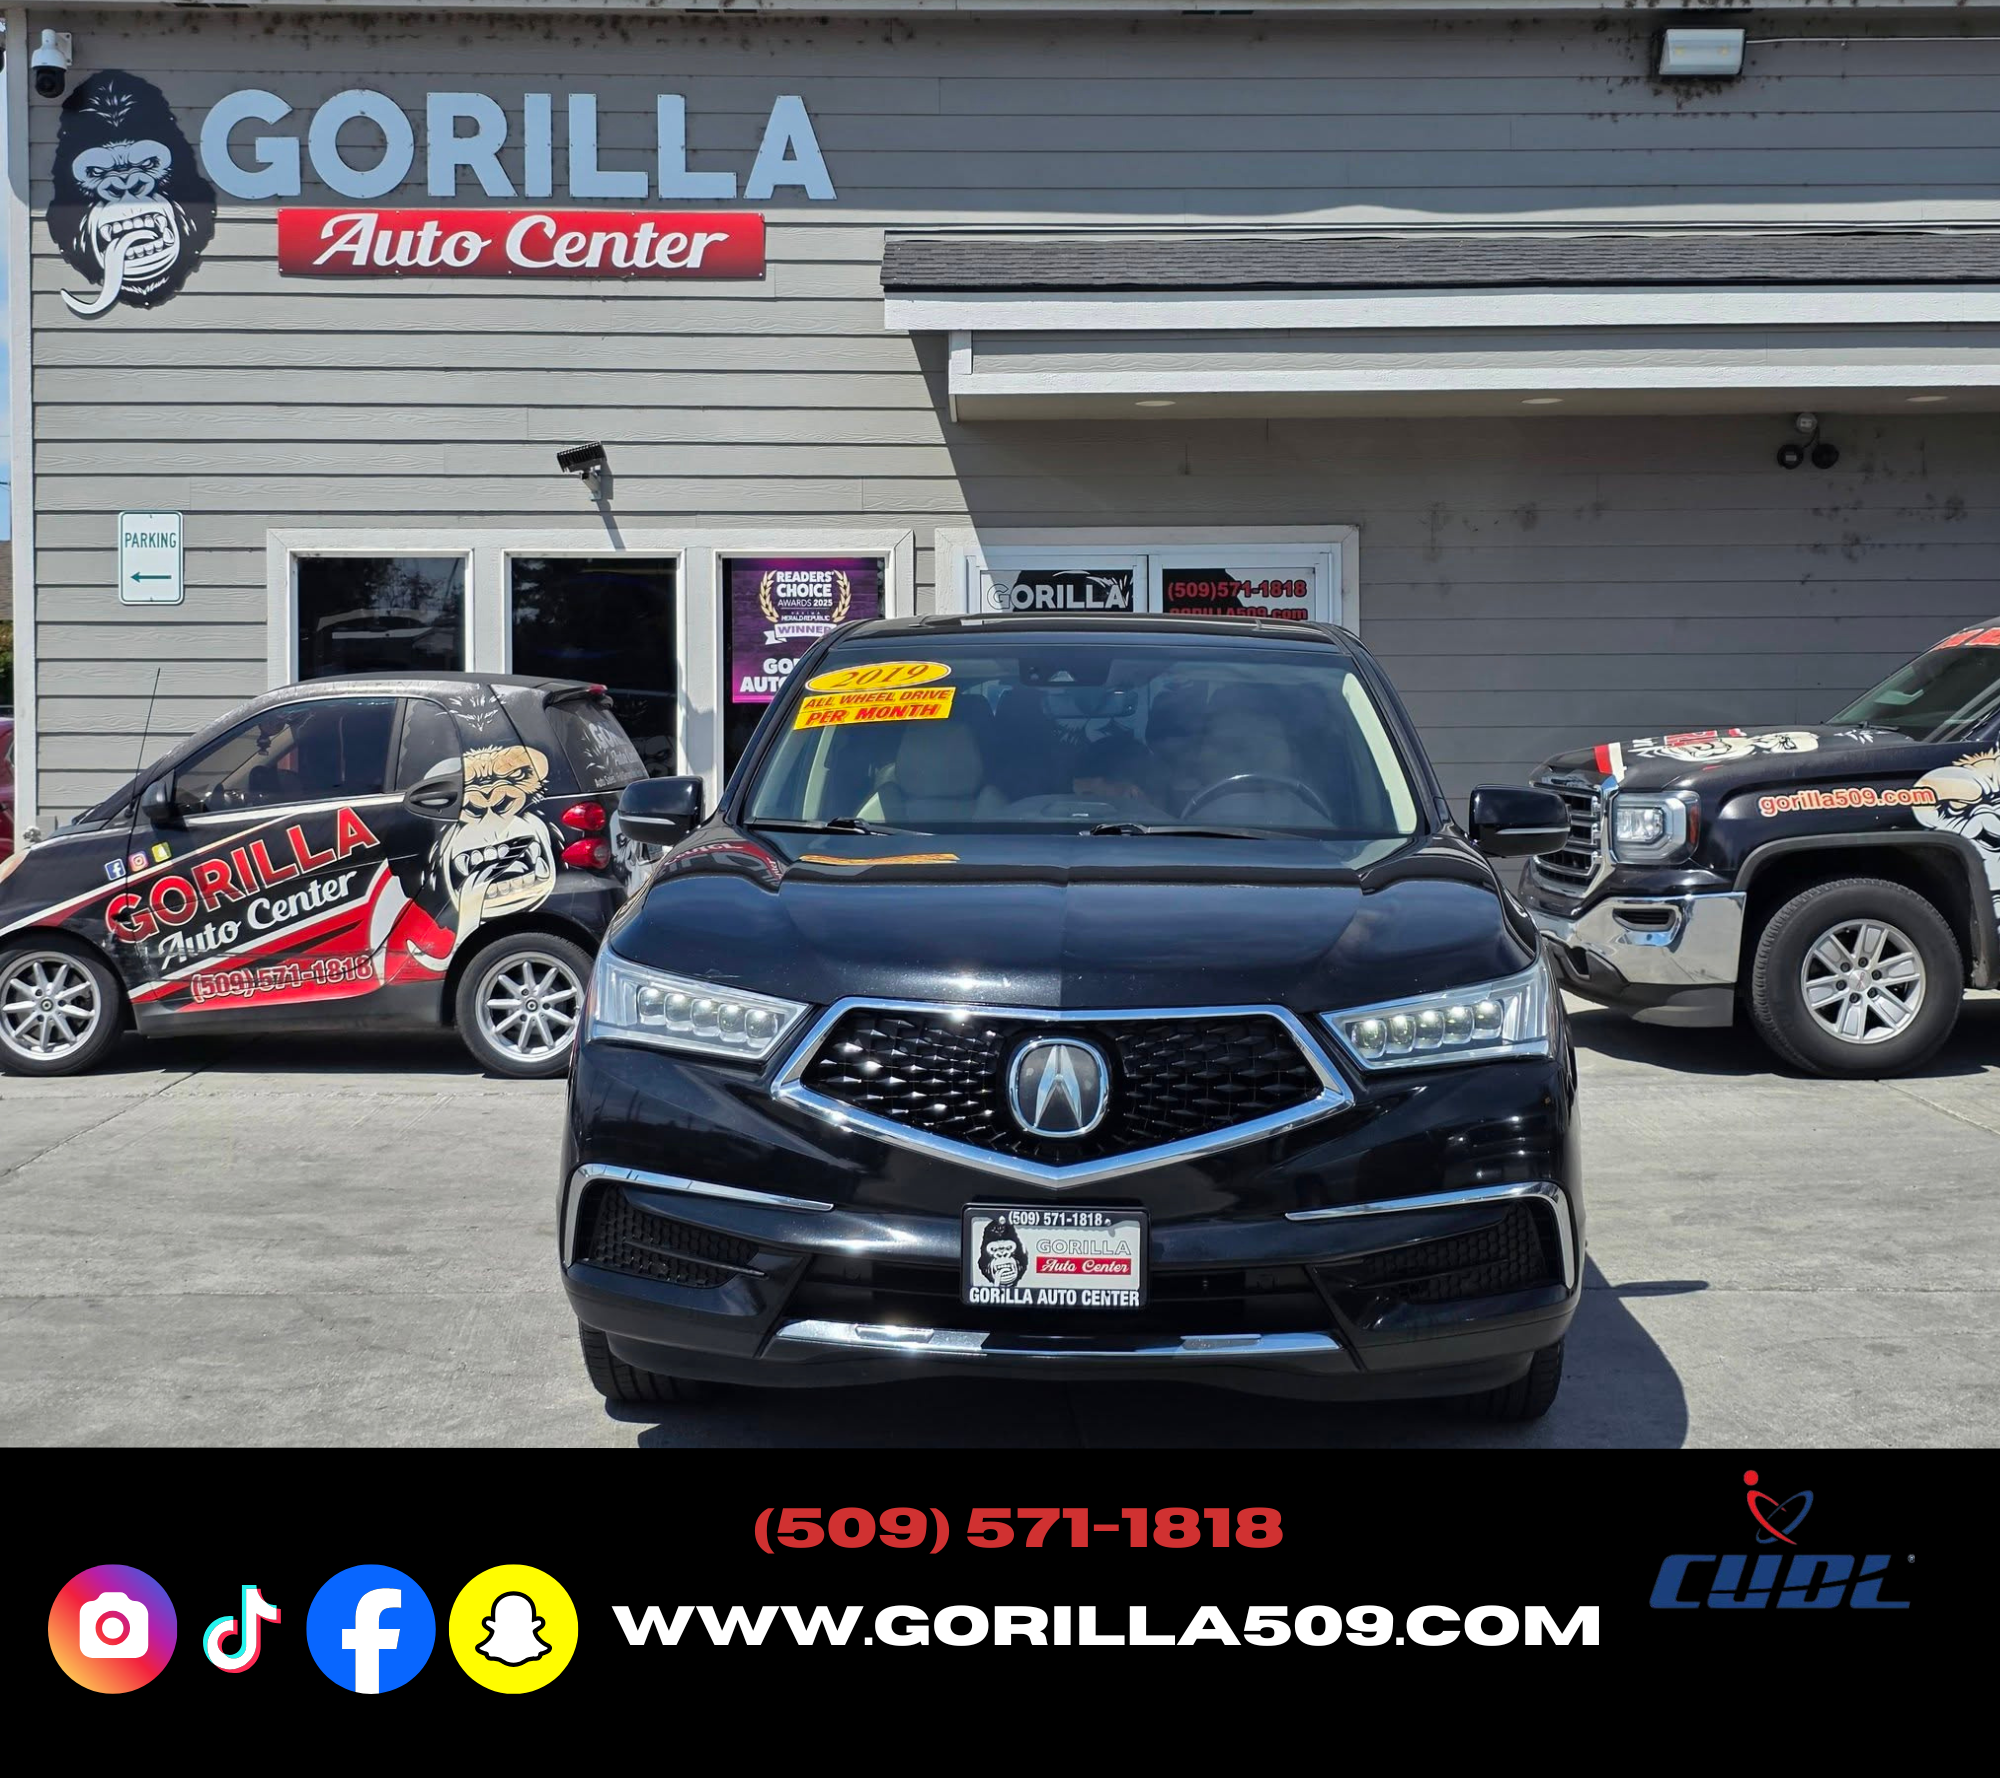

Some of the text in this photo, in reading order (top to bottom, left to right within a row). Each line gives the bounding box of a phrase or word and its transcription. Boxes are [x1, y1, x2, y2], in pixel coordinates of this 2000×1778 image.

[200, 89, 837, 200] GORILLA
[313, 212, 729, 270] Auto Center
[125, 532, 177, 548] PARKING
[776, 570, 834, 583] READERS'
[776, 583, 832, 597] CHOICE
[987, 583, 1126, 610] GORILLA
[778, 599, 833, 607] AWARDS 2025
[831, 664, 929, 688] 2019
[804, 689, 951, 709] ALL WHEEL DRIVE
[806, 703, 940, 726] PER MONTH
[1758, 786, 1937, 817] gorilla509.com
[105, 806, 380, 944] GORILLA
[158, 871, 357, 970] Auto Center
[1008, 1211, 1103, 1227] (509) 571-1818
[1035, 1239, 1131, 1256] GORILLA
[1040, 1258, 1130, 1273] Auto Center
[969, 1286, 1140, 1307] GORILLA AUTO CENTER
